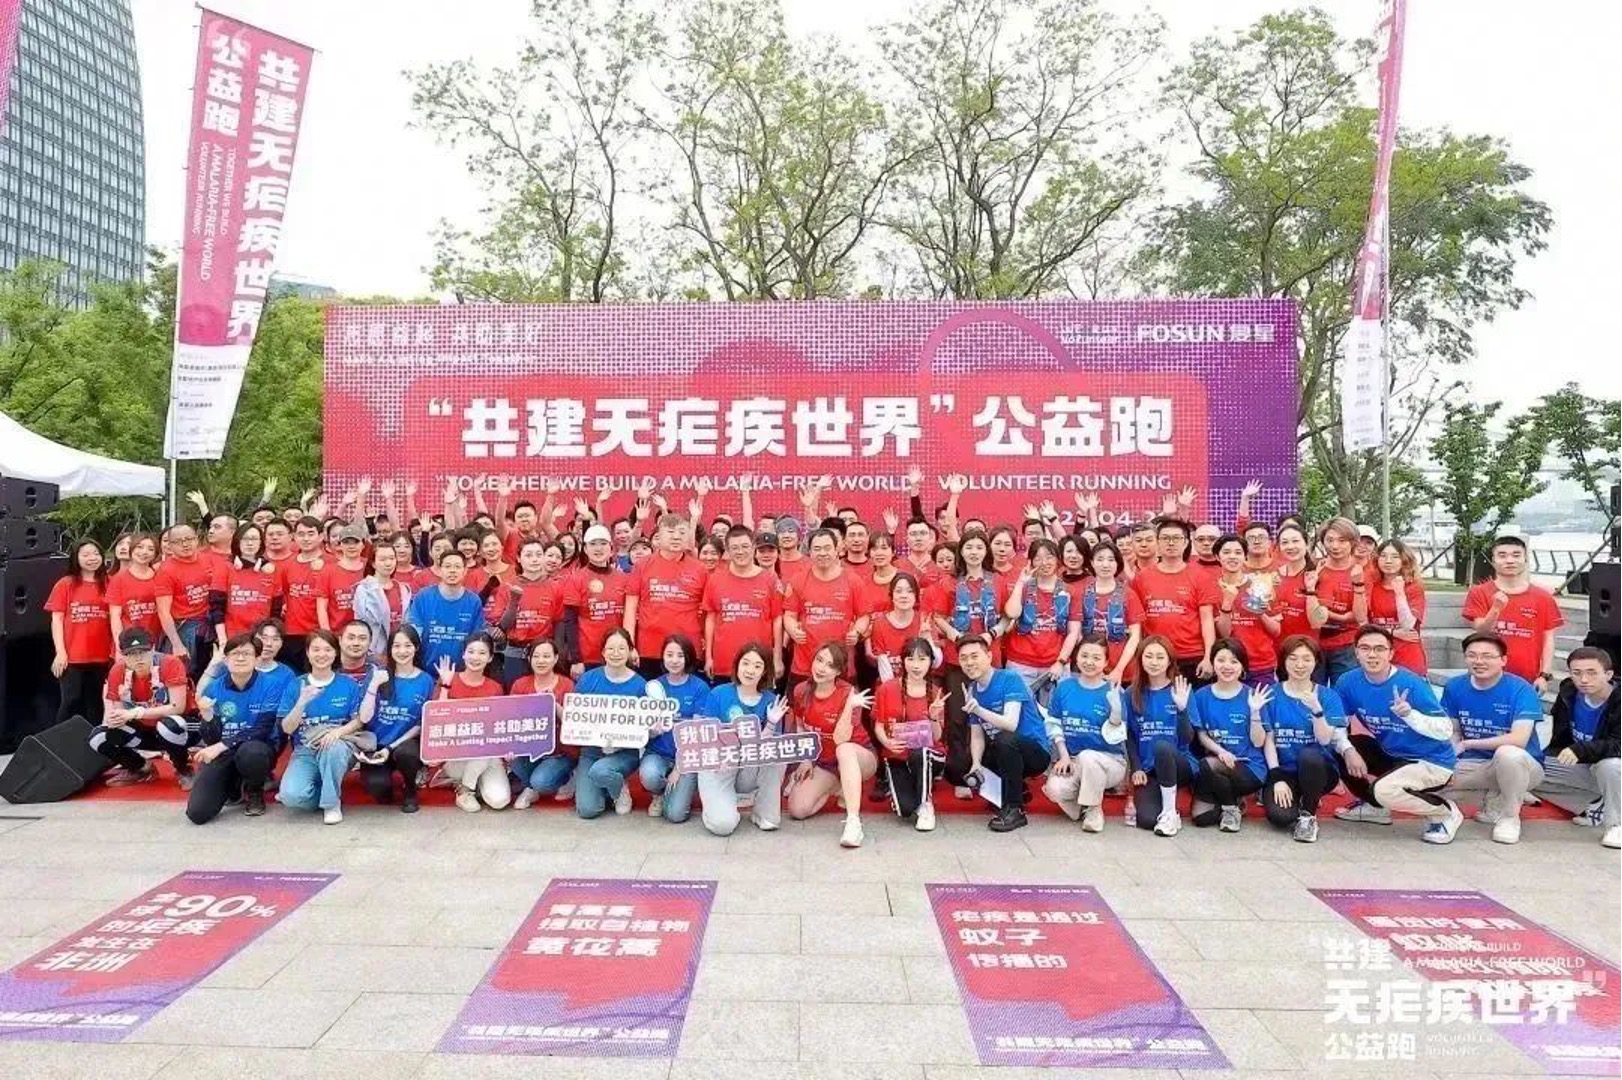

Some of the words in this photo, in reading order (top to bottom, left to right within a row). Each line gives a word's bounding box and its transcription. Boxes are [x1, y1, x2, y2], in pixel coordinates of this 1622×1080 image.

[227, 49, 300, 343] 共建无疟疾世界
[201, 239, 213, 280] WORLD
[1137, 325, 1223, 343] FOSUN
[971, 395, 1174, 458] 公益跑
[661, 474, 676, 490] A
[1070, 474, 1172, 490] RUNNING
[566, 696, 609, 709] FOSUN
[611, 698, 637, 710] FOR
[640, 699, 677, 712] GOOD
[564, 711, 608, 724] FOSUN
[610, 713, 636, 725] FOR
[680, 720, 757, 744] 我们一起
[682, 737, 816, 767] 共建无疟疾世界
[164, 894, 278, 918] 90%
[959, 928, 1048, 946] 蚊子
[33, 951, 142, 972] 非洲
